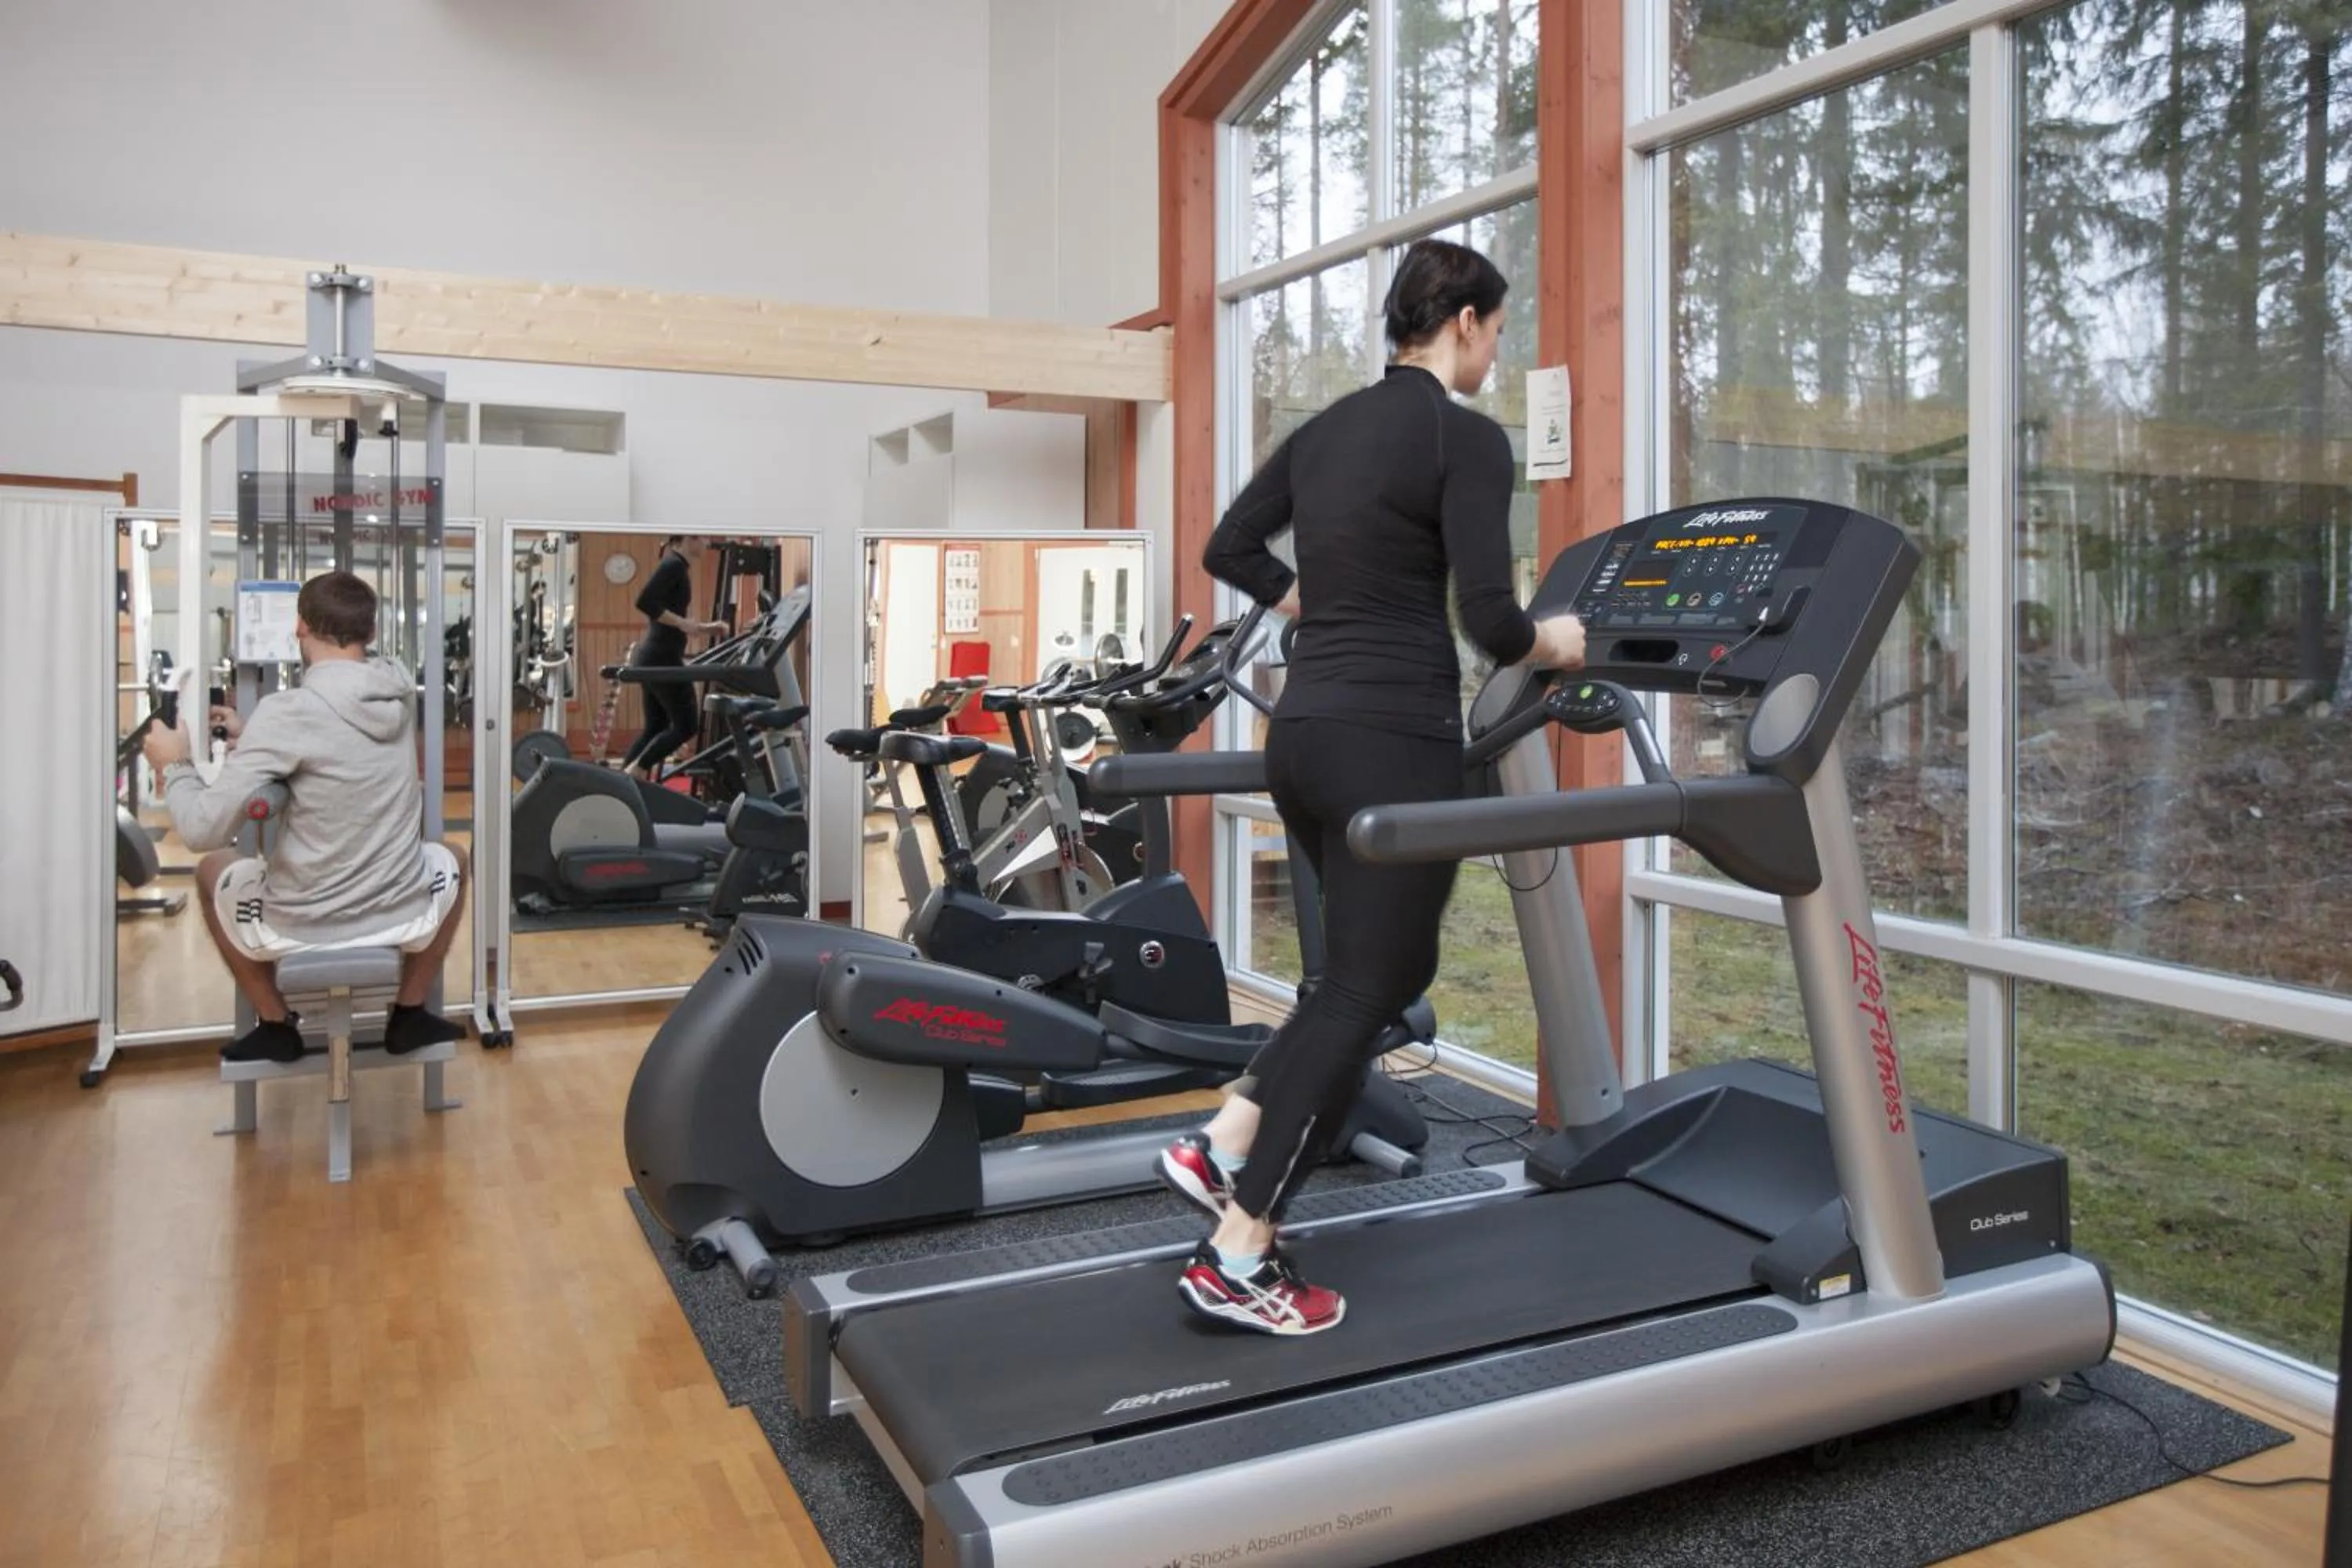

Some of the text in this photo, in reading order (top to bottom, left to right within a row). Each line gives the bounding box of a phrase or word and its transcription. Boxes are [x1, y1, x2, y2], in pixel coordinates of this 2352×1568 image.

[1189, 1543, 1242, 1568] Shock
[1246, 1520, 1334, 1555] Absorption
[1336, 1504, 1393, 1530] System
